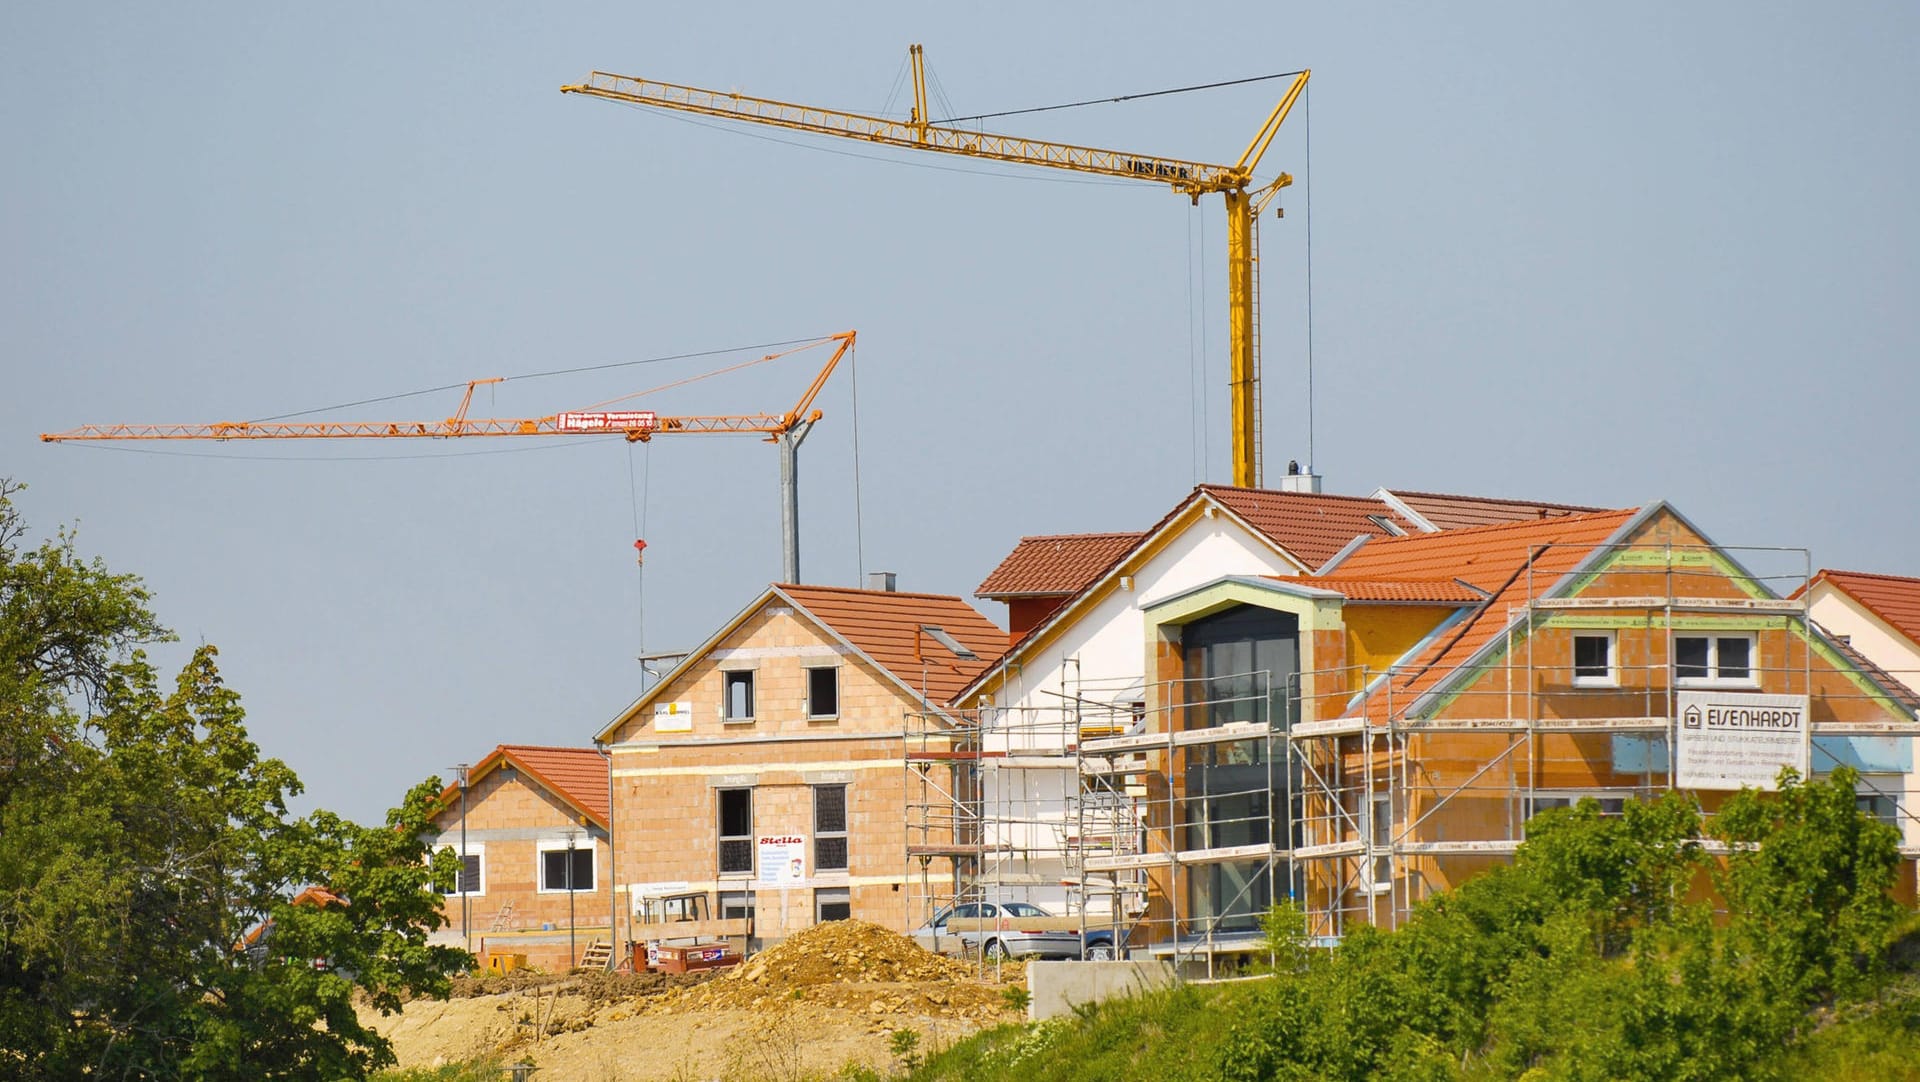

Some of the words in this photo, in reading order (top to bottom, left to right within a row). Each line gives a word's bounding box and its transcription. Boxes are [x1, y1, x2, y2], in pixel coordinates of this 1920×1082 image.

[566, 419, 604, 430] Hägele
[1707, 708, 1801, 728] EISENHARDT
[760, 836, 802, 844] Stella
